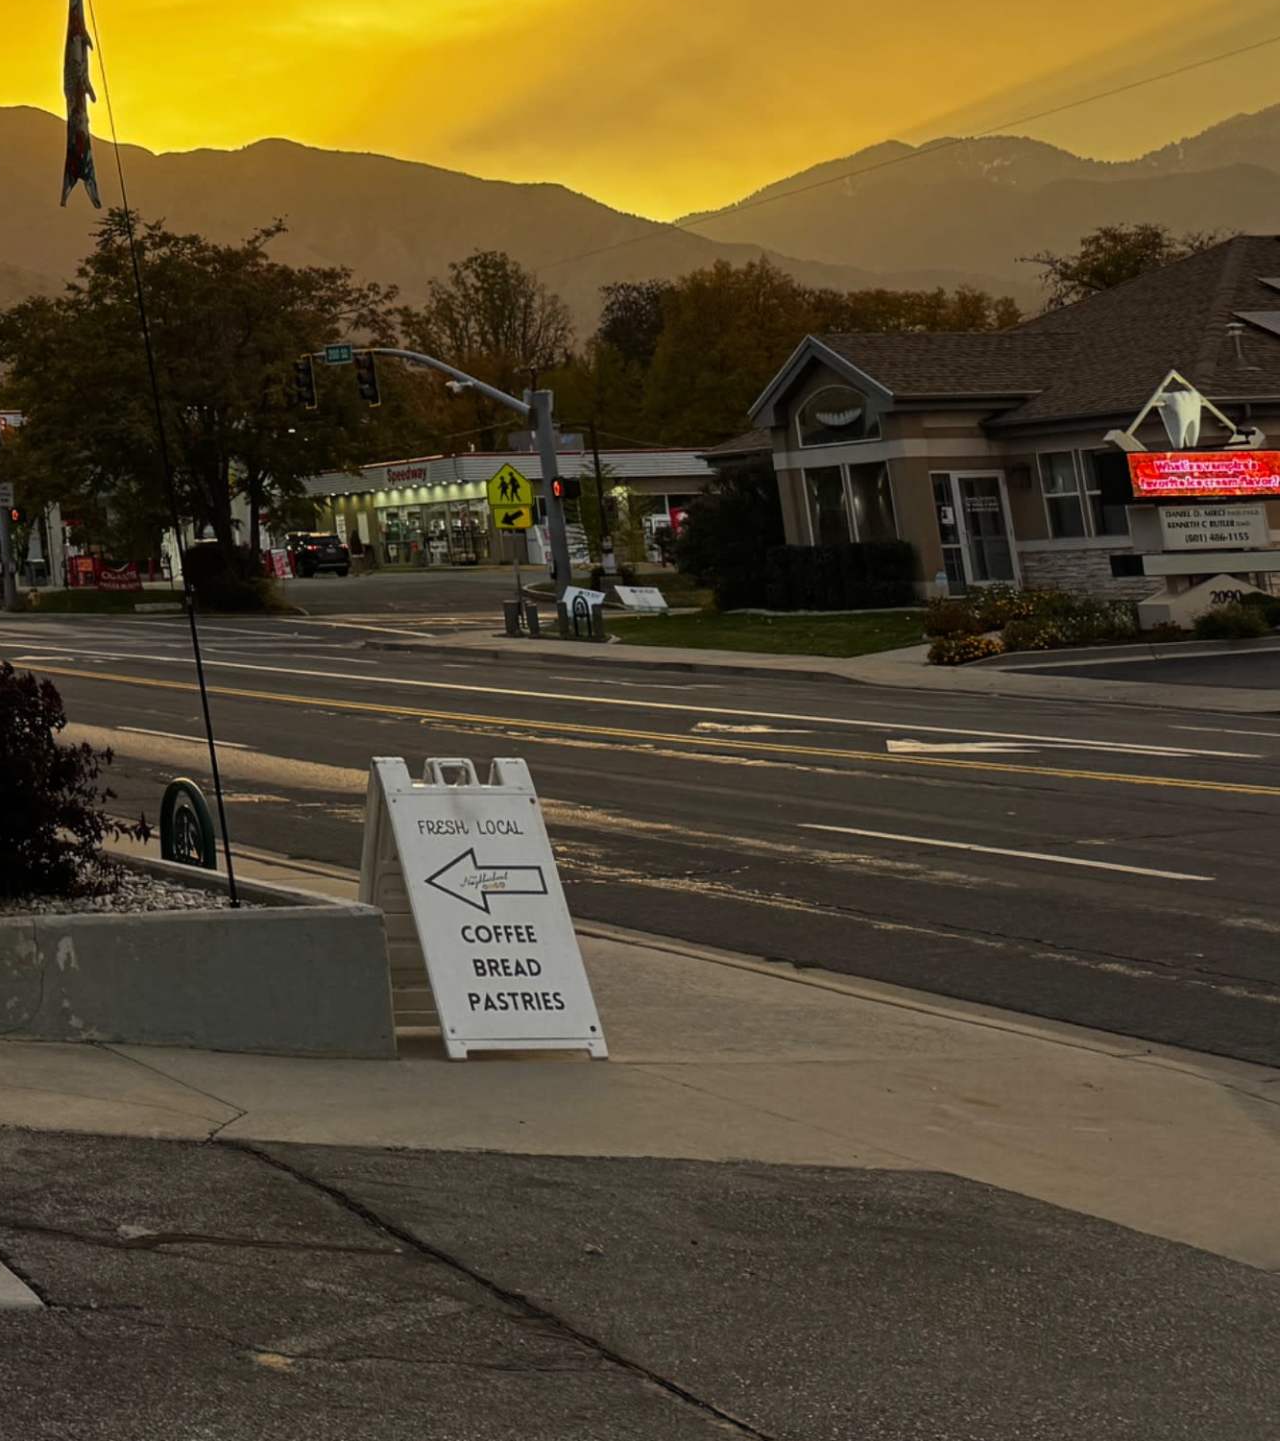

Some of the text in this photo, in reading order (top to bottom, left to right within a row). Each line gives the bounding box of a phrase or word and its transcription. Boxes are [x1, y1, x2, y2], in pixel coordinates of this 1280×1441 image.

[386, 466, 428, 485] Speedway
[418, 820, 525, 836] FRESH LOCAL
[461, 925, 538, 943] COFFEE
[473, 958, 542, 977] BREAD
[467, 992, 565, 1011] PASTRIES
